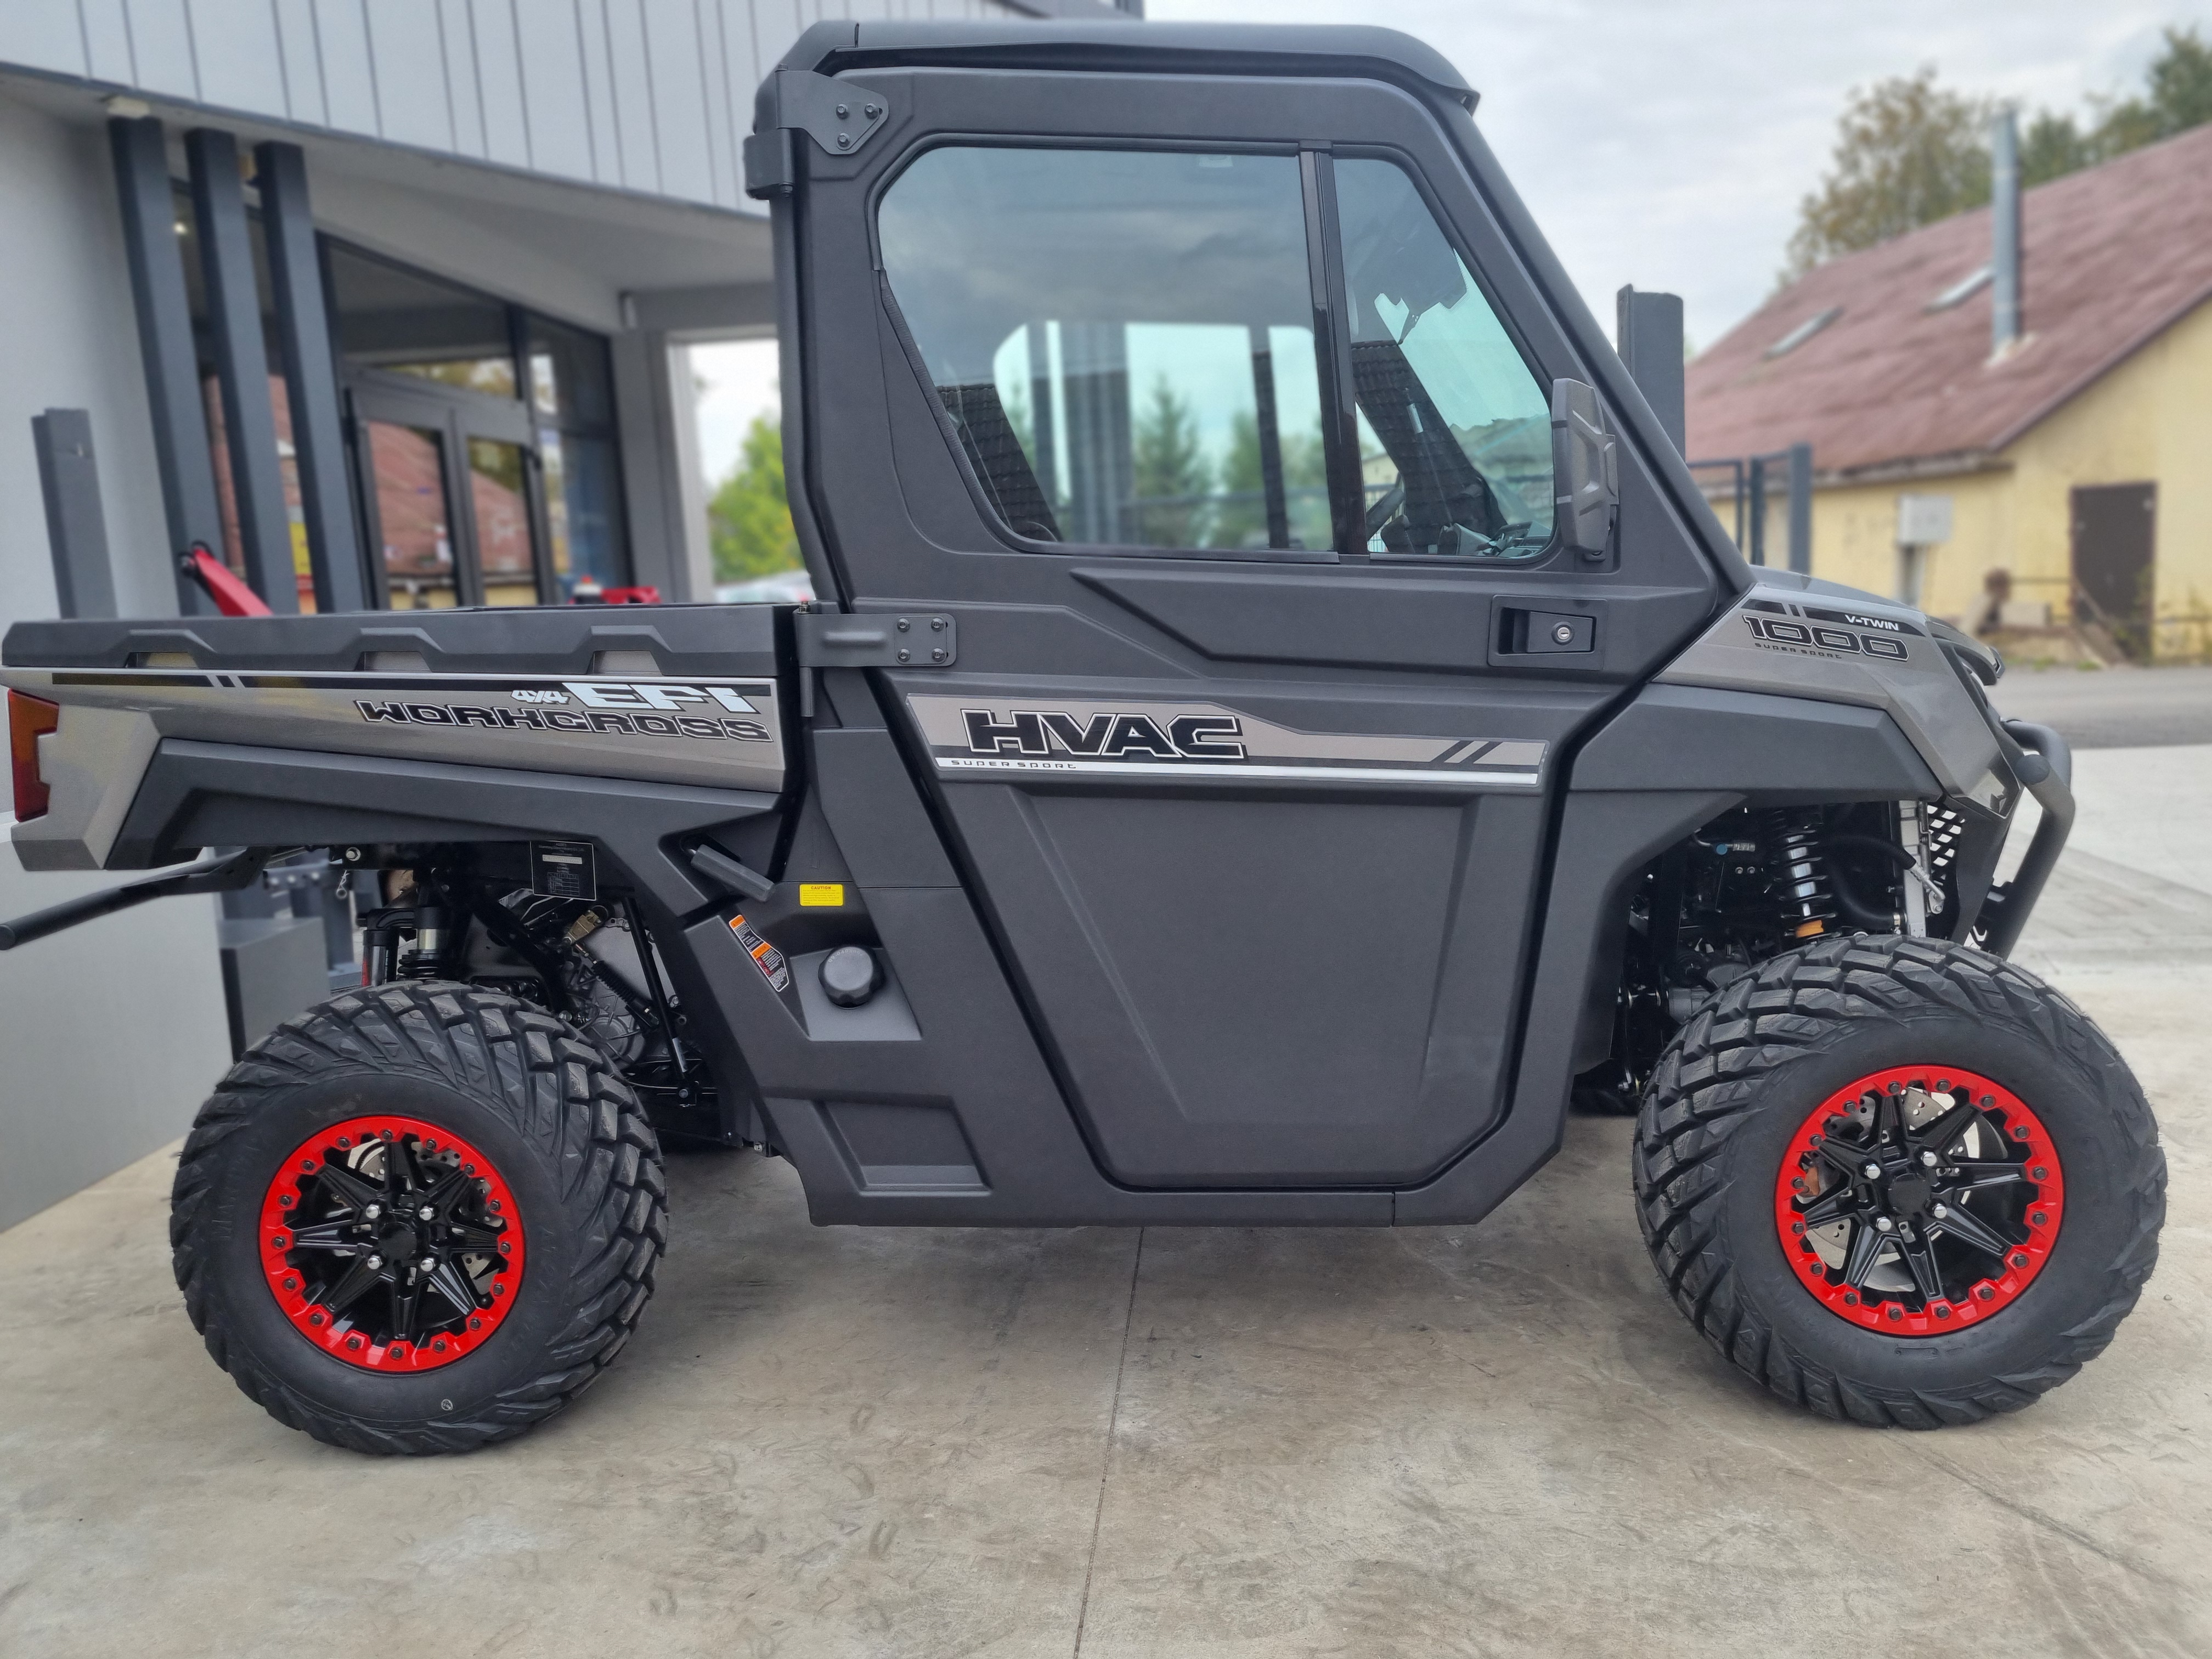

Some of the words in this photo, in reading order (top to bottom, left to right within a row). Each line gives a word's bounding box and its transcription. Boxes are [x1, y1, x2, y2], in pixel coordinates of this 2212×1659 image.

[1742, 614, 1910, 662] 1000
[1844, 614, 1899, 631] V-TWIN
[561, 682, 762, 714] EFI
[353, 699, 775, 743] WORKCROSS
[960, 708, 1249, 761] HVAC
